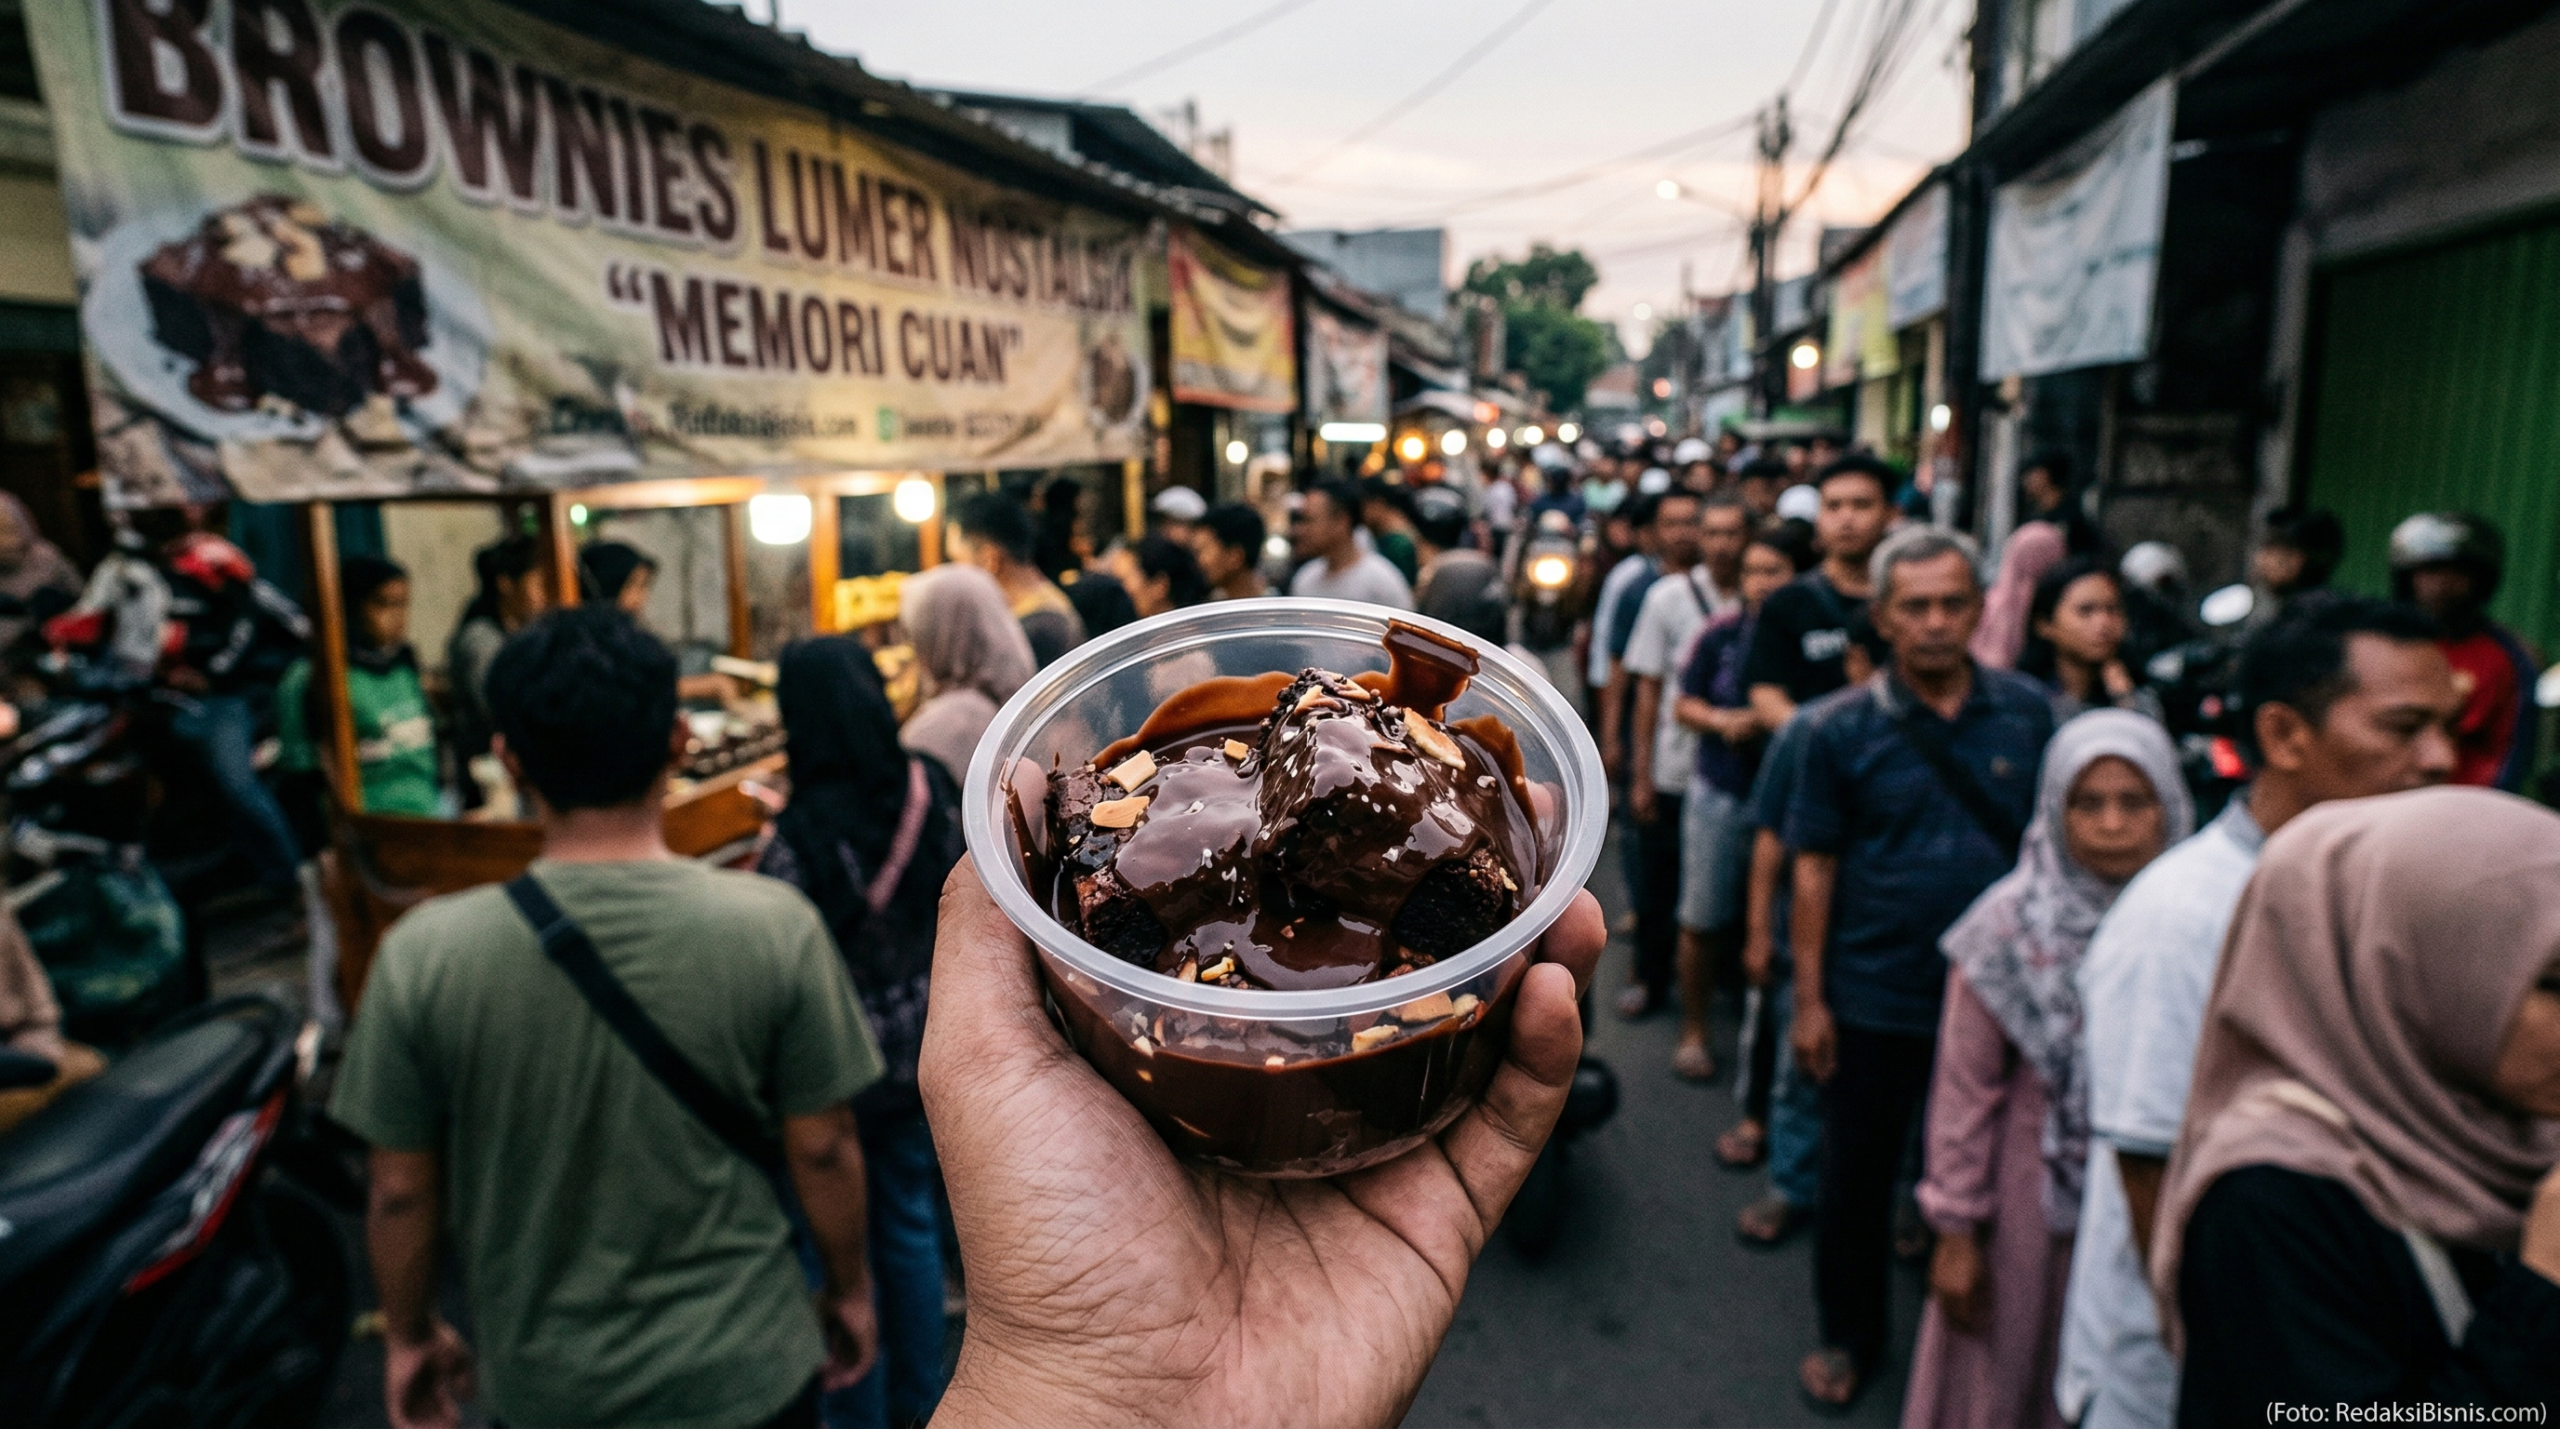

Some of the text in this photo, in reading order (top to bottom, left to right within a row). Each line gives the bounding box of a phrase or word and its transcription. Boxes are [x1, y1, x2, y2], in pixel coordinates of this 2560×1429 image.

[103, 0, 741, 246] BROWNIES
[752, 138, 938, 281] LUMER
[608, 263, 886, 378] “MEMORI
